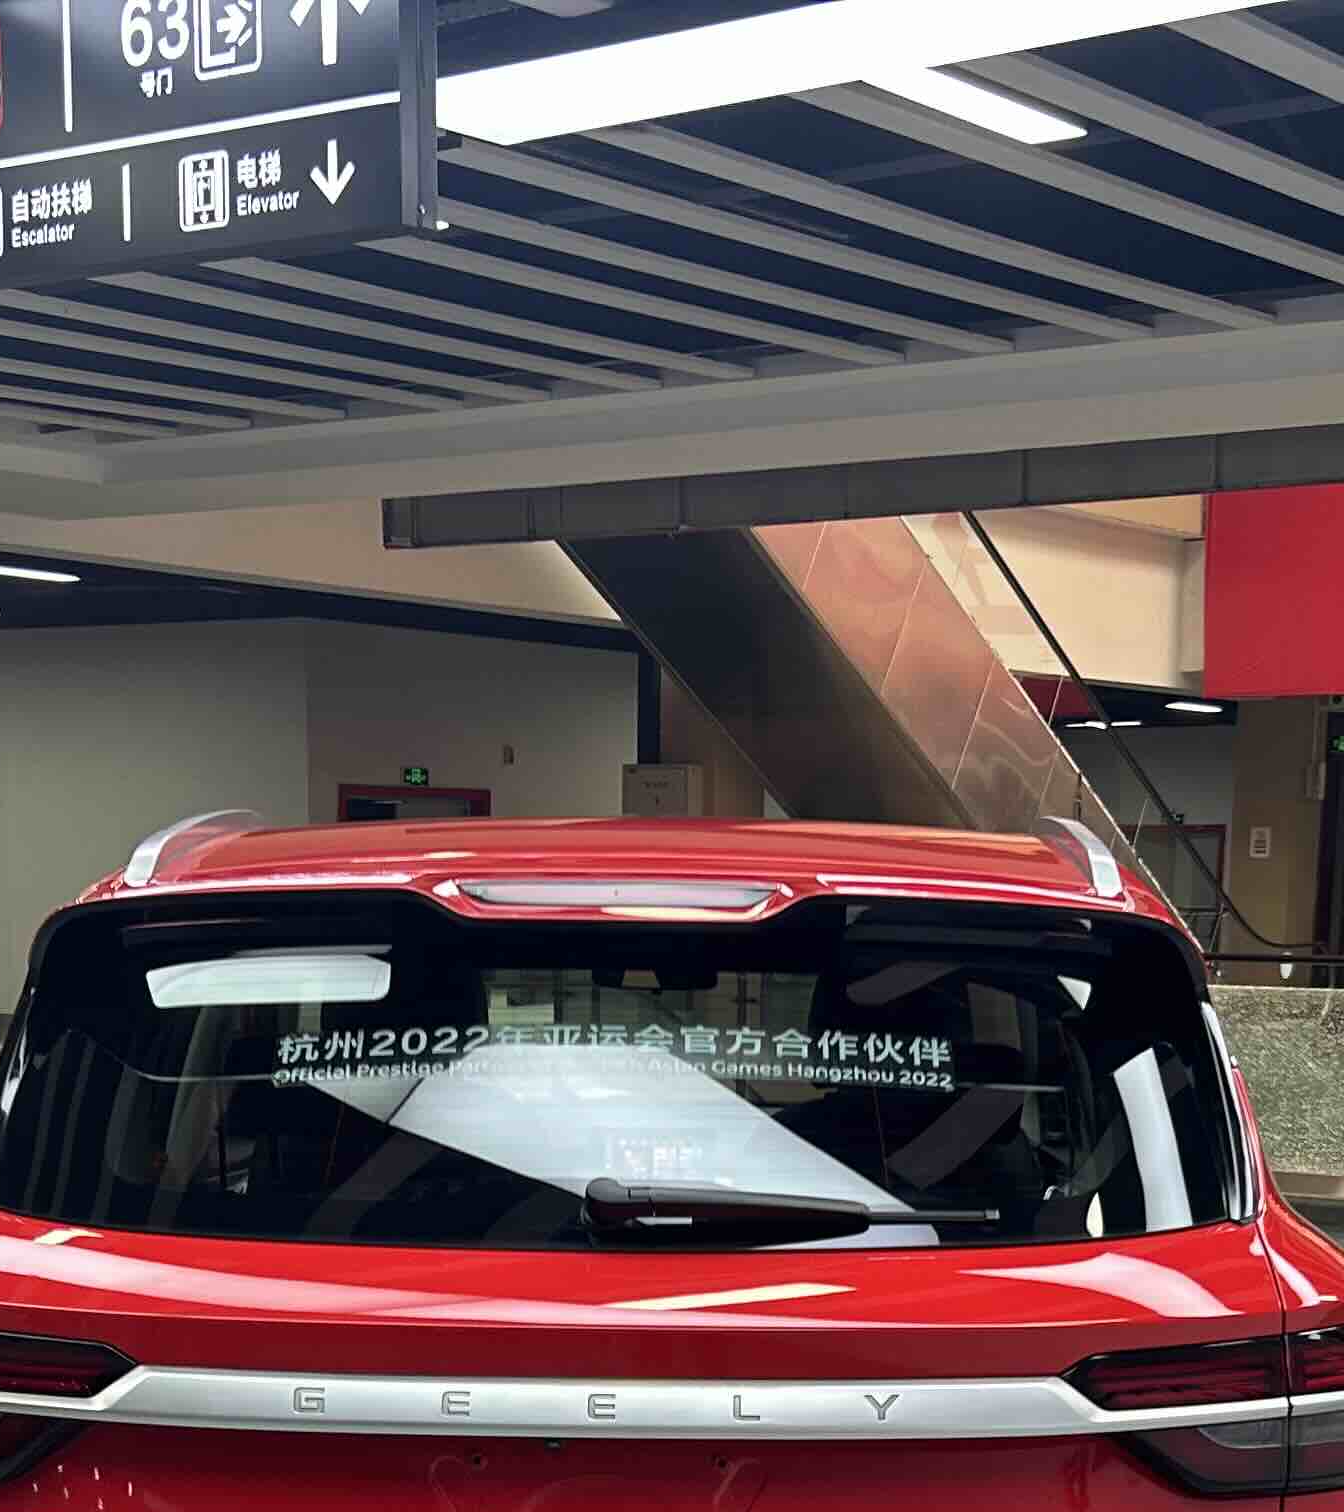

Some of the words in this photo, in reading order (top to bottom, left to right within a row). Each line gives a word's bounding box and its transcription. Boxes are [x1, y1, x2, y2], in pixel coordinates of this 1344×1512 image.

[121, 0, 190, 67] 63
[139, 67, 173, 98] 号门
[237, 149, 282, 187] 电梯
[11, 178, 94, 224] 自动扶梯
[237, 188, 300, 217] Elevator
[11, 222, 75, 249] Escalator
[712, 1058, 783, 1078] Games
[787, 1058, 895, 1085] Hangzhou
[899, 1068, 953, 1088] 2022
[293, 1386, 901, 1421] GEELY
